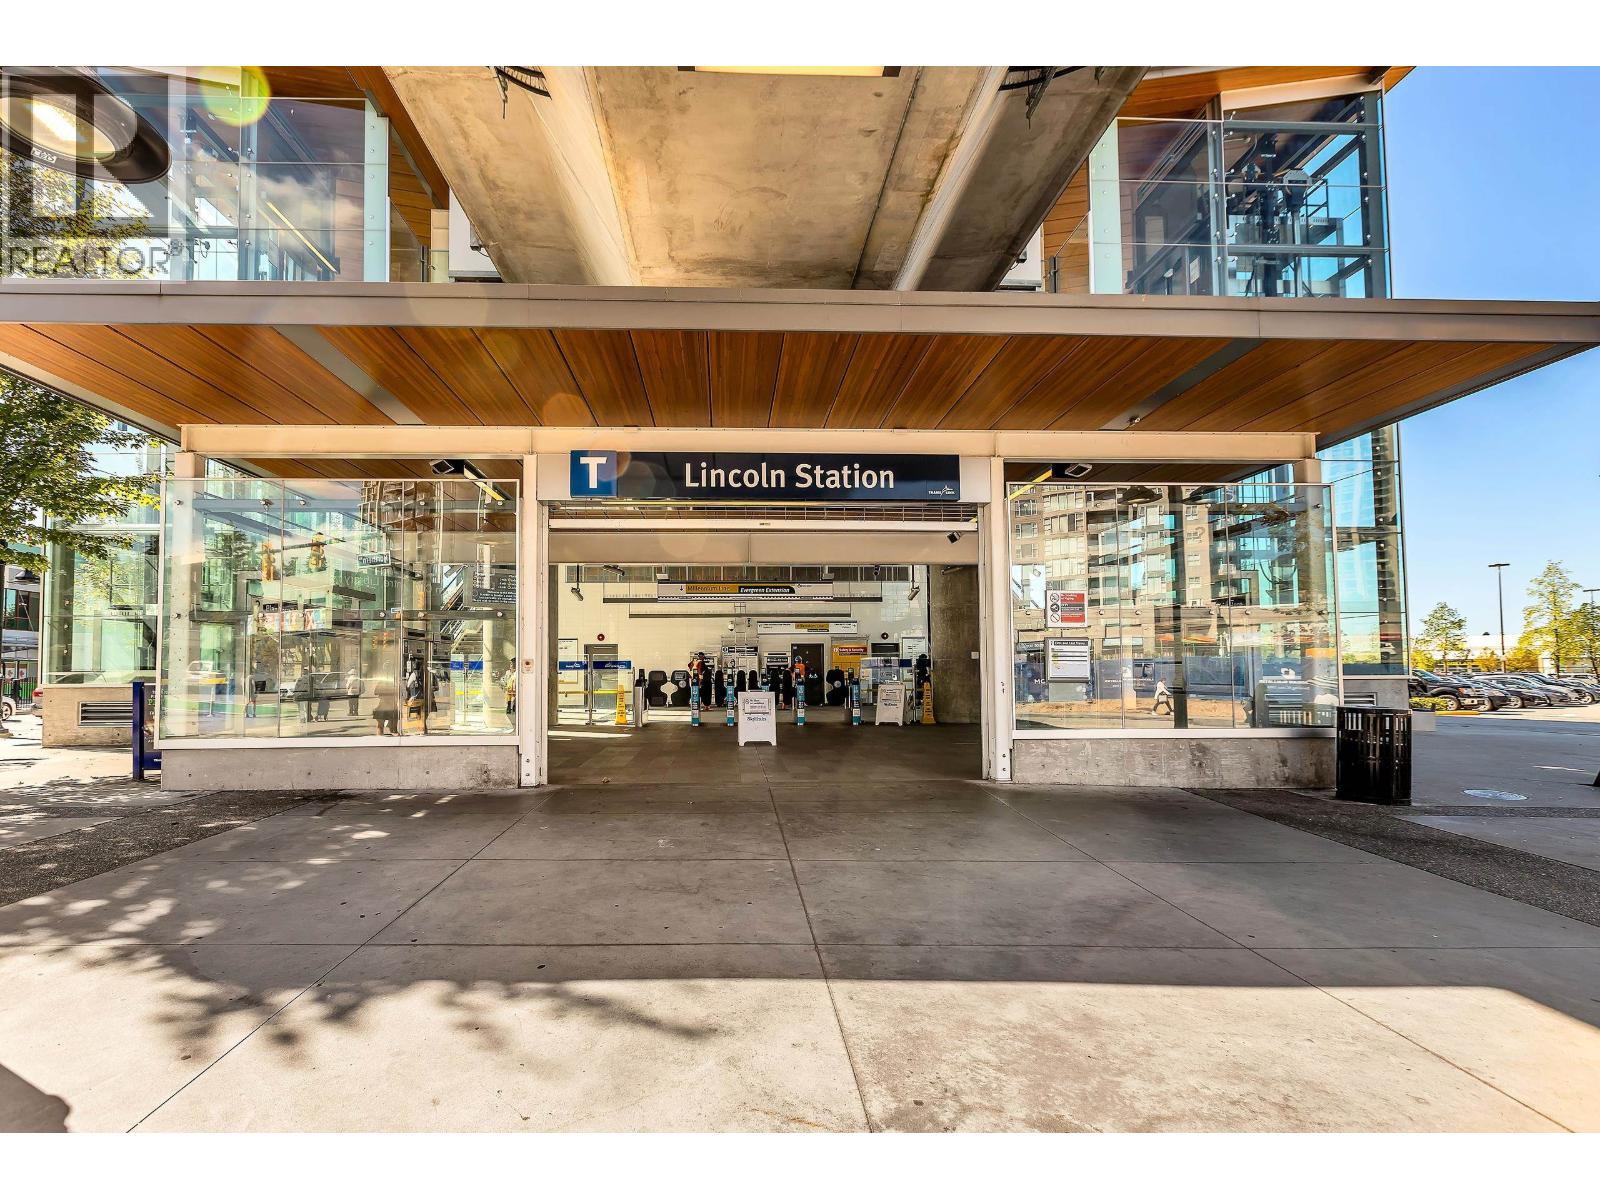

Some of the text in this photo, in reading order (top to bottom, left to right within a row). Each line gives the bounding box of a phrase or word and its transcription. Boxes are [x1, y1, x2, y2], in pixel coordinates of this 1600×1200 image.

[579, 456, 608, 489] T
[684, 461, 895, 490] Lincoln Station
